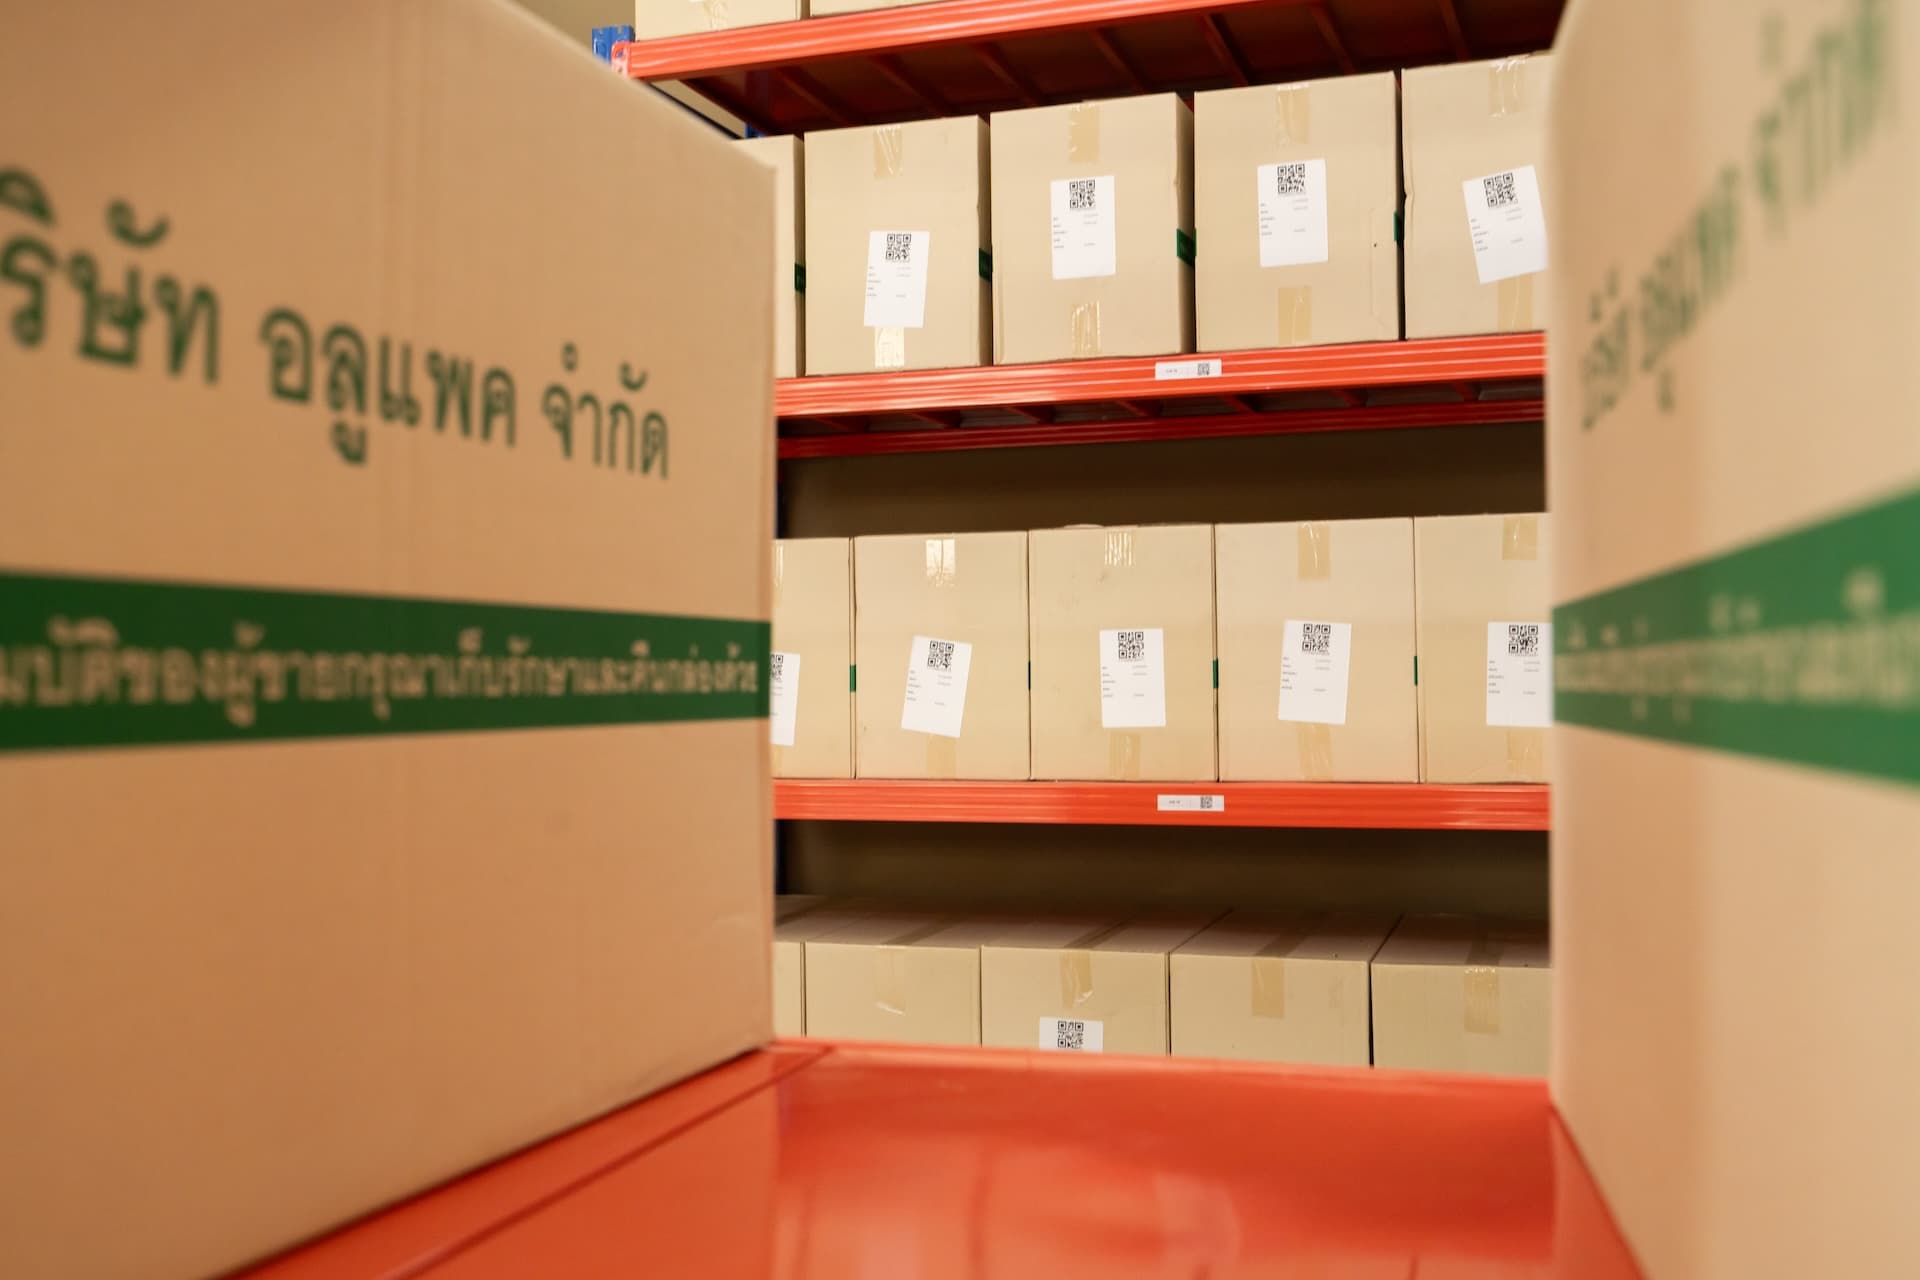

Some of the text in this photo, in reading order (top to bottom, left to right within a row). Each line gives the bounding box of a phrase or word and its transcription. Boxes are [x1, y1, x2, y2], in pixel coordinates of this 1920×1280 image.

[259, 306, 517, 467] อลูแพค
[540, 341, 669, 480] จำกัด
